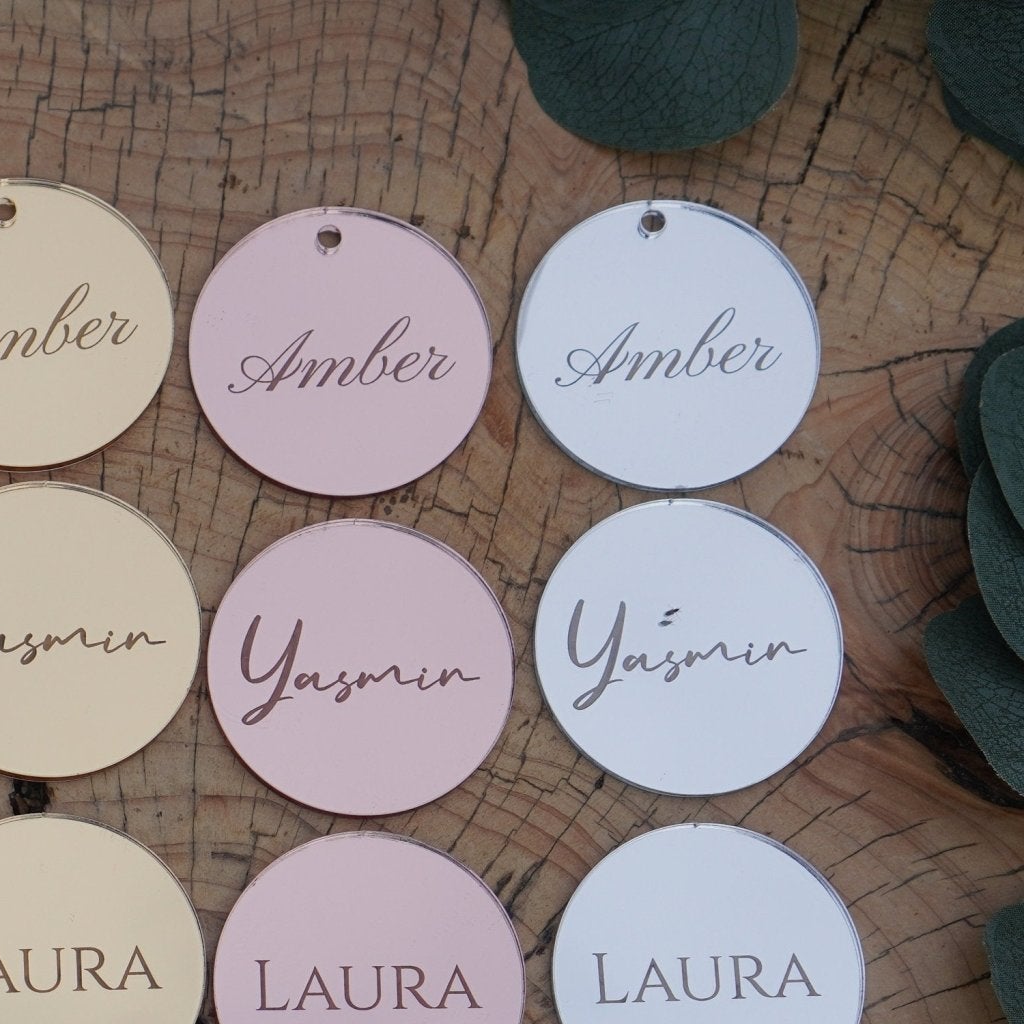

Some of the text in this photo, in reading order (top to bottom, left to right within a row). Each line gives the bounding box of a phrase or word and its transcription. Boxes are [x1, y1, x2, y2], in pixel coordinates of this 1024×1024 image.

[227, 316, 456, 394] Amber
[555, 307, 782, 387] Amber
[239, 614, 481, 726] Yasmin
[567, 598, 807, 711] Yasmin
